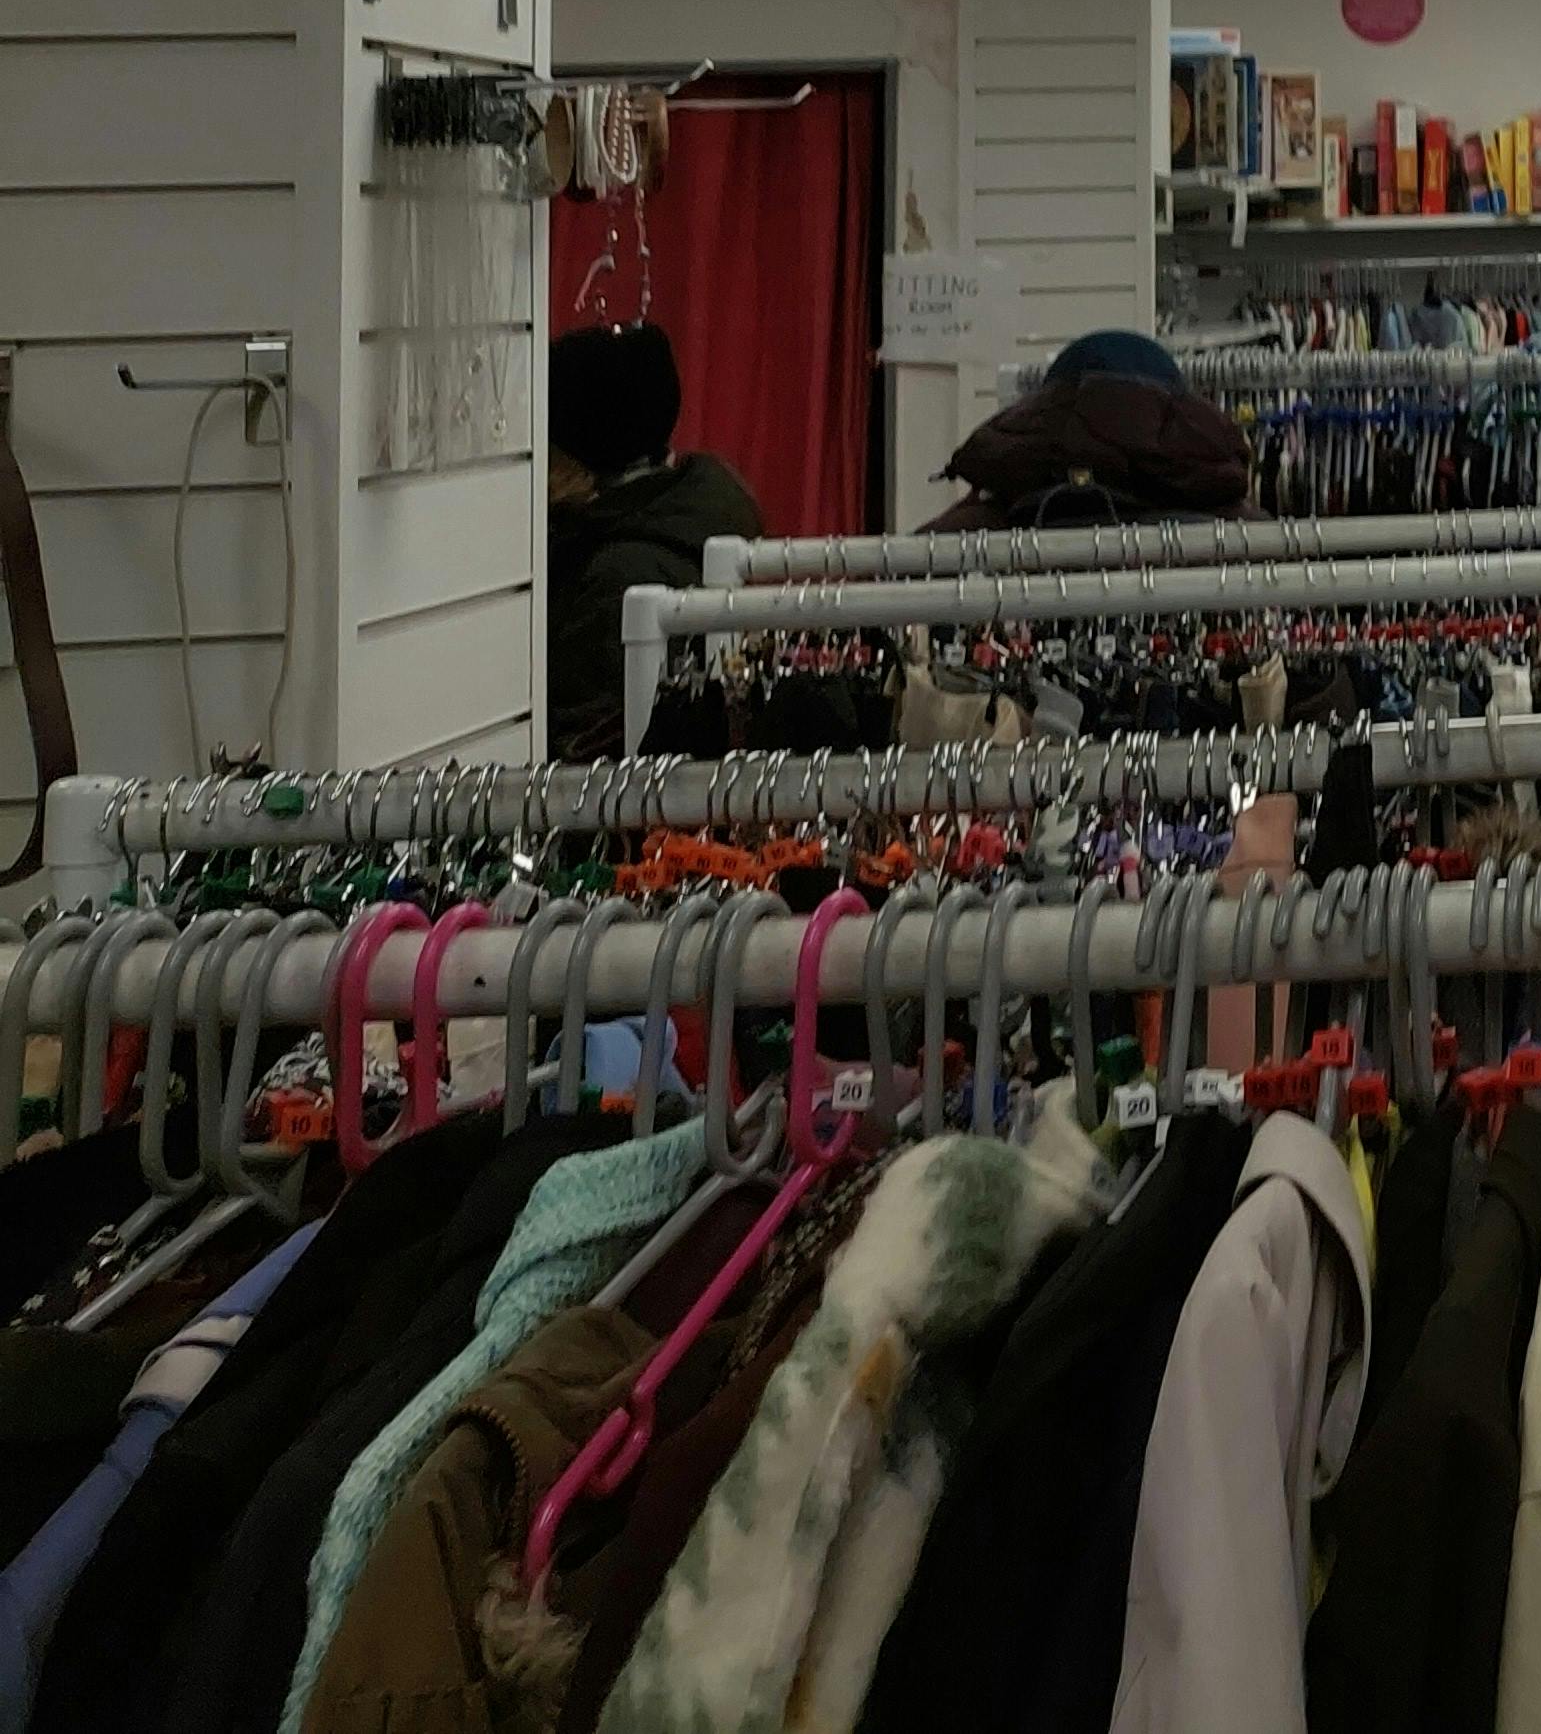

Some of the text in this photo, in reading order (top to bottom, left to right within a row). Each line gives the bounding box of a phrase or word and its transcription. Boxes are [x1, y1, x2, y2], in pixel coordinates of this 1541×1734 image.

[839, 1082, 862, 1099] 20
[1127, 1096, 1150, 1118] 20
[291, 1116, 311, 1135] 10
